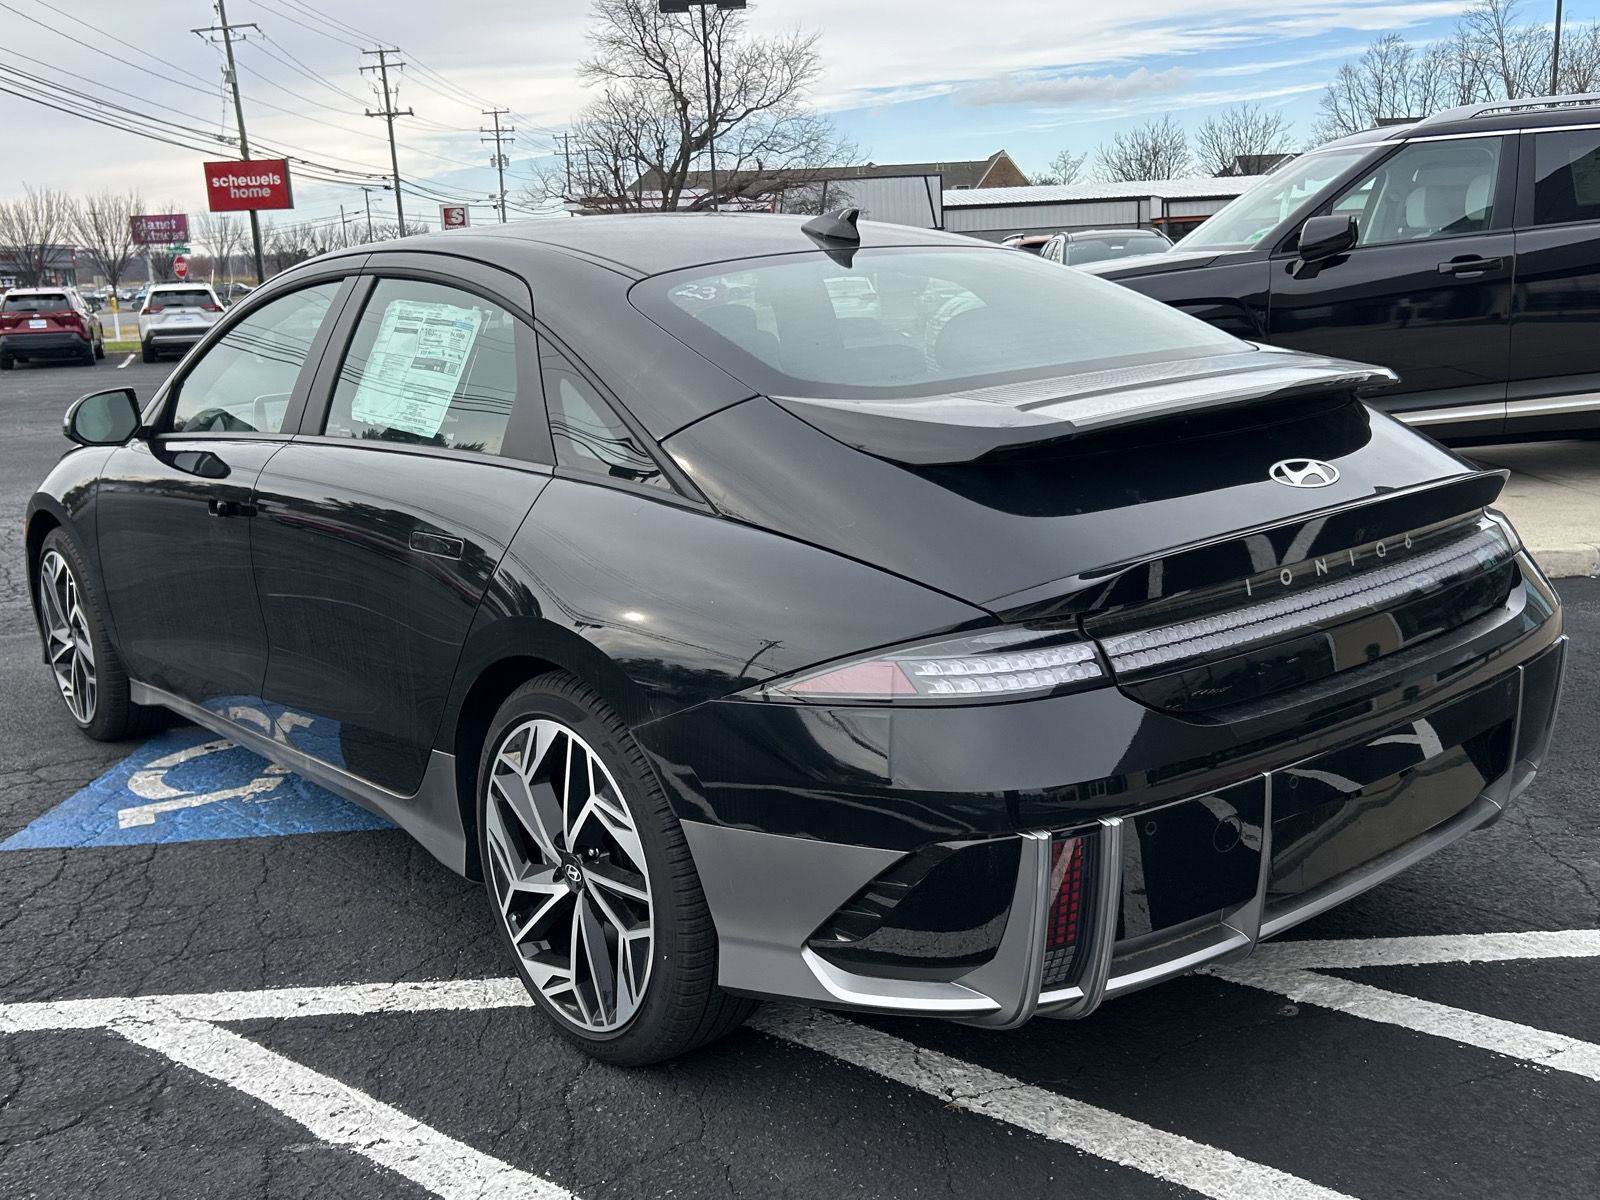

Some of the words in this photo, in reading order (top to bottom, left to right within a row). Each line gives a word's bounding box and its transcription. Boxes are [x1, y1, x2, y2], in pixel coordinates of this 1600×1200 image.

[212, 173, 281, 187] schewels
[231, 187, 271, 198] home
[1245, 541, 1386, 596] IONIQ
[1404, 534, 1412, 549] 6
